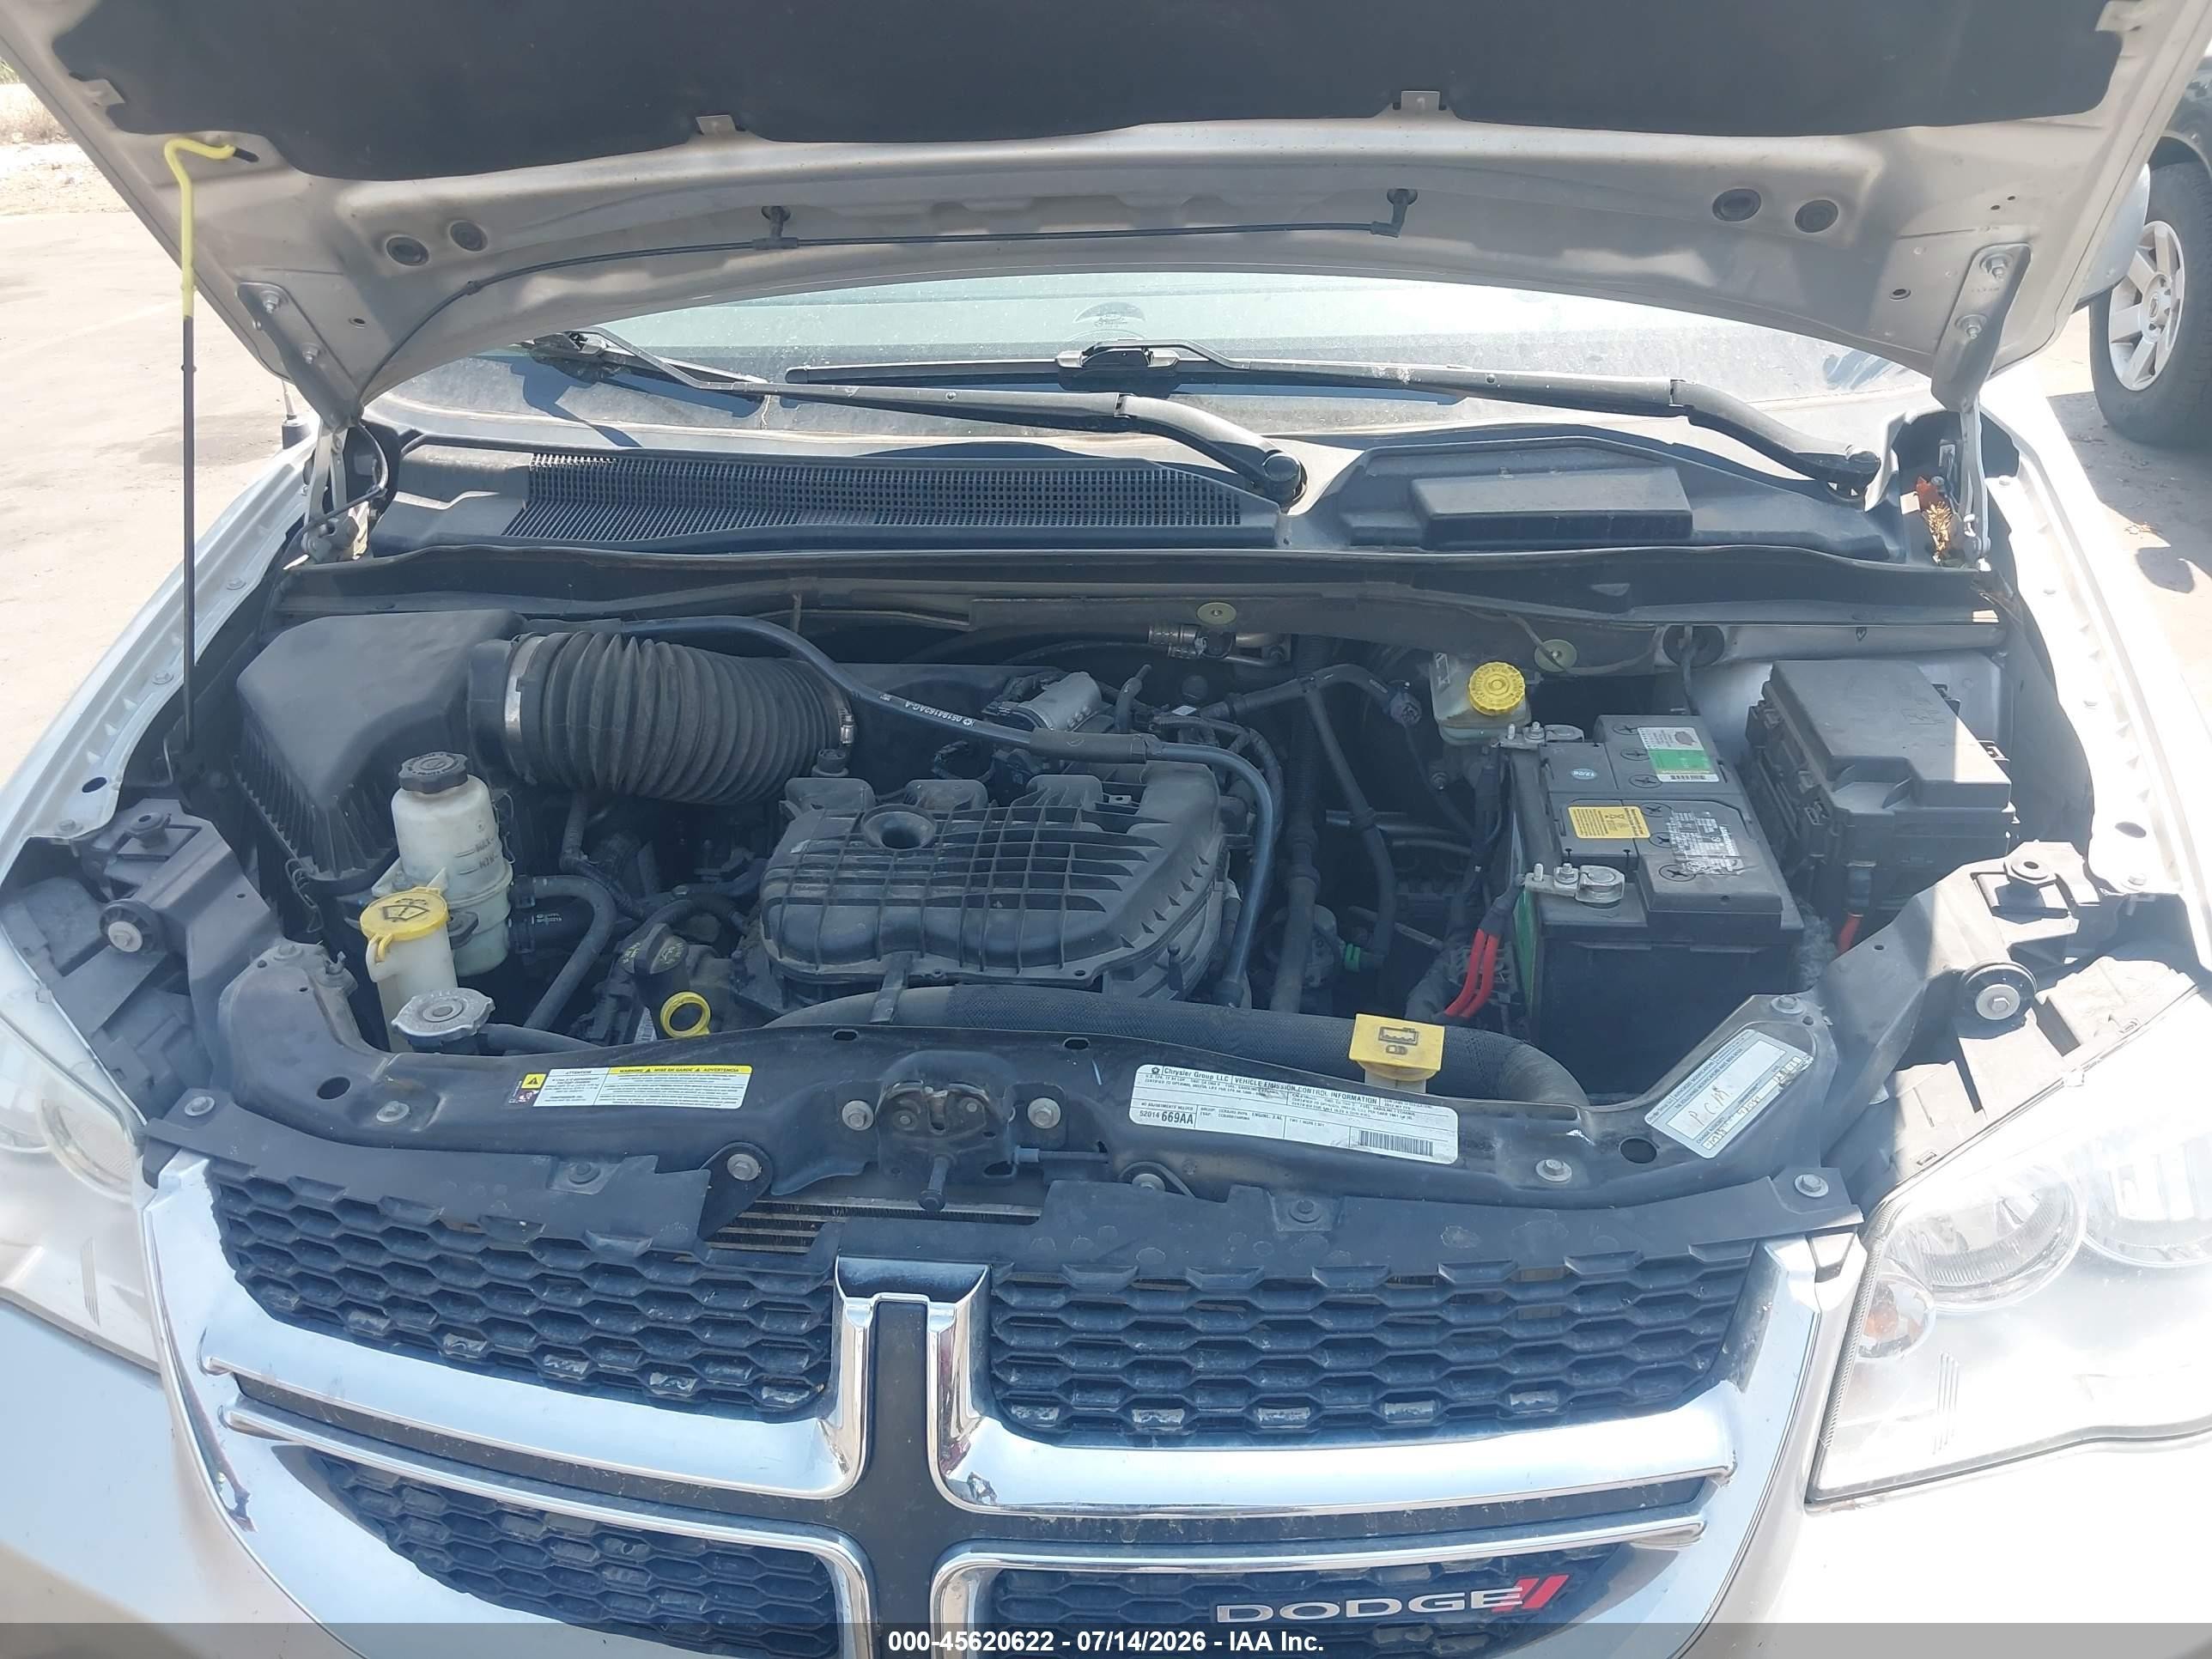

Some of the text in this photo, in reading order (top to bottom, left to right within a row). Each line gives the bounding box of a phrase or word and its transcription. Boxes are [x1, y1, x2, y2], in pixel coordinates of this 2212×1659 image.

[1164, 1067, 1191, 1078] Chrysler
[1194, 1071, 1214, 1080] Group
[1235, 1077, 1262, 1087] VEHICLE
[1263, 1081, 1296, 1092] EMISSION
[1297, 1085, 1328, 1097] CONTROL
[1330, 1089, 1377, 1104] INFORMATION
[1139, 1110, 1194, 1125] 52014 669AA
[1217, 1586, 1523, 1623] DODGE
